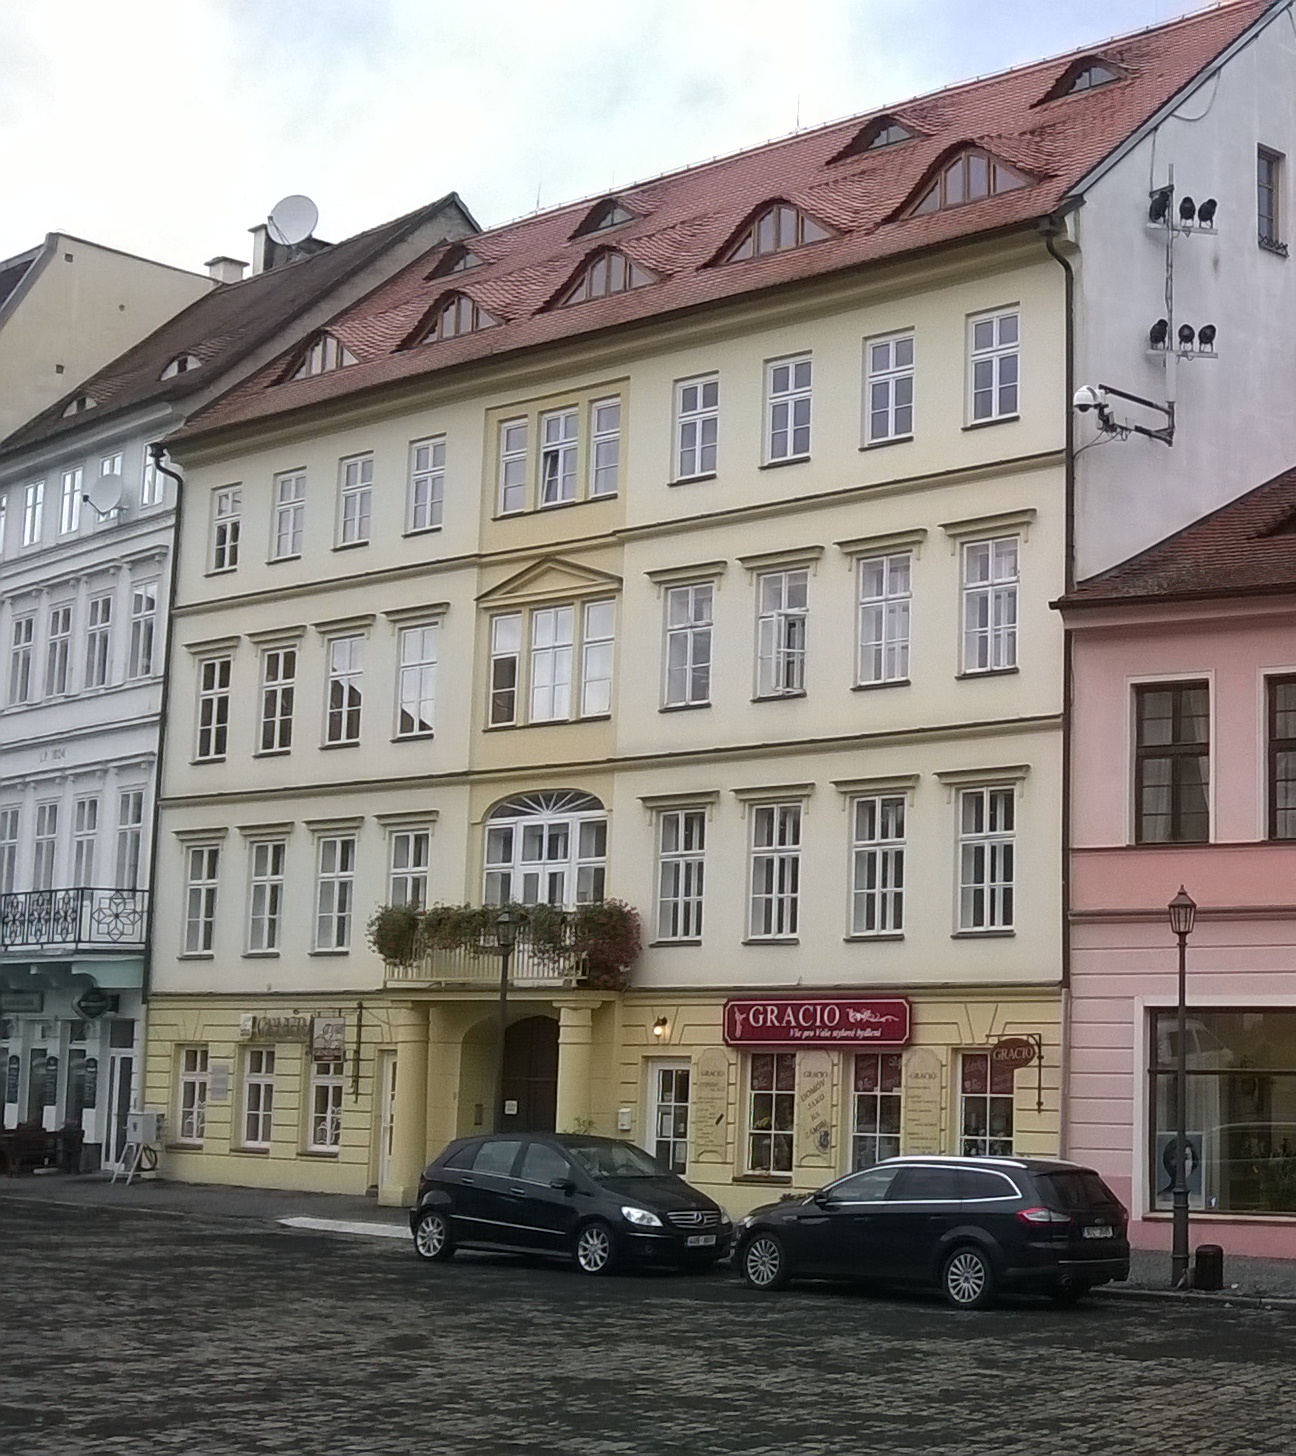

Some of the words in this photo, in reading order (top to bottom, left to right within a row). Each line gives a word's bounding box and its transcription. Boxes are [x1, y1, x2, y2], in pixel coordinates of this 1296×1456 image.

[749, 1005, 840, 1027] GRACIO
[802, 1029, 815, 1039] pro
[992, 1046, 1034, 1061] GRACIO
